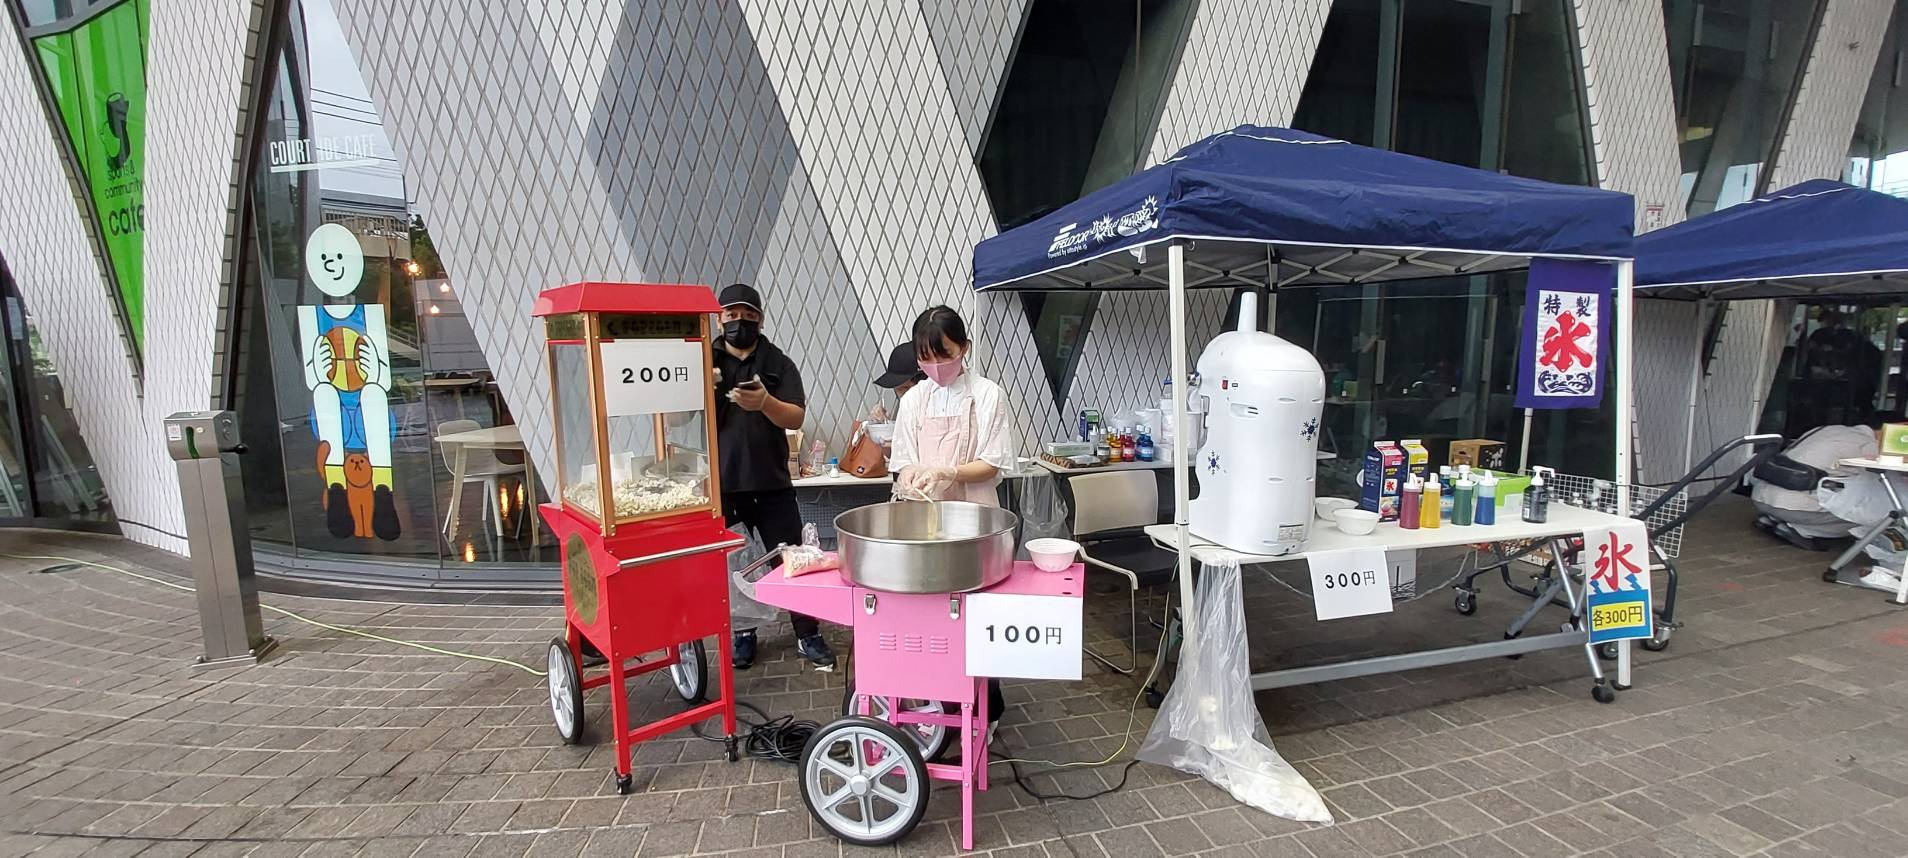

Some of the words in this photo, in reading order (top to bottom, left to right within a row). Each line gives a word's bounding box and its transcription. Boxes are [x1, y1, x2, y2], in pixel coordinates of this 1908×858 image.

[345, 134, 376, 159] CAFE
[1540, 310, 1593, 373] 氷
[622, 366, 688, 384] 200円
[1590, 531, 1642, 591] 氷
[1325, 571, 1376, 589] 300円
[1593, 605, 1643, 627] 各300円
[985, 624, 1061, 645] 100円
